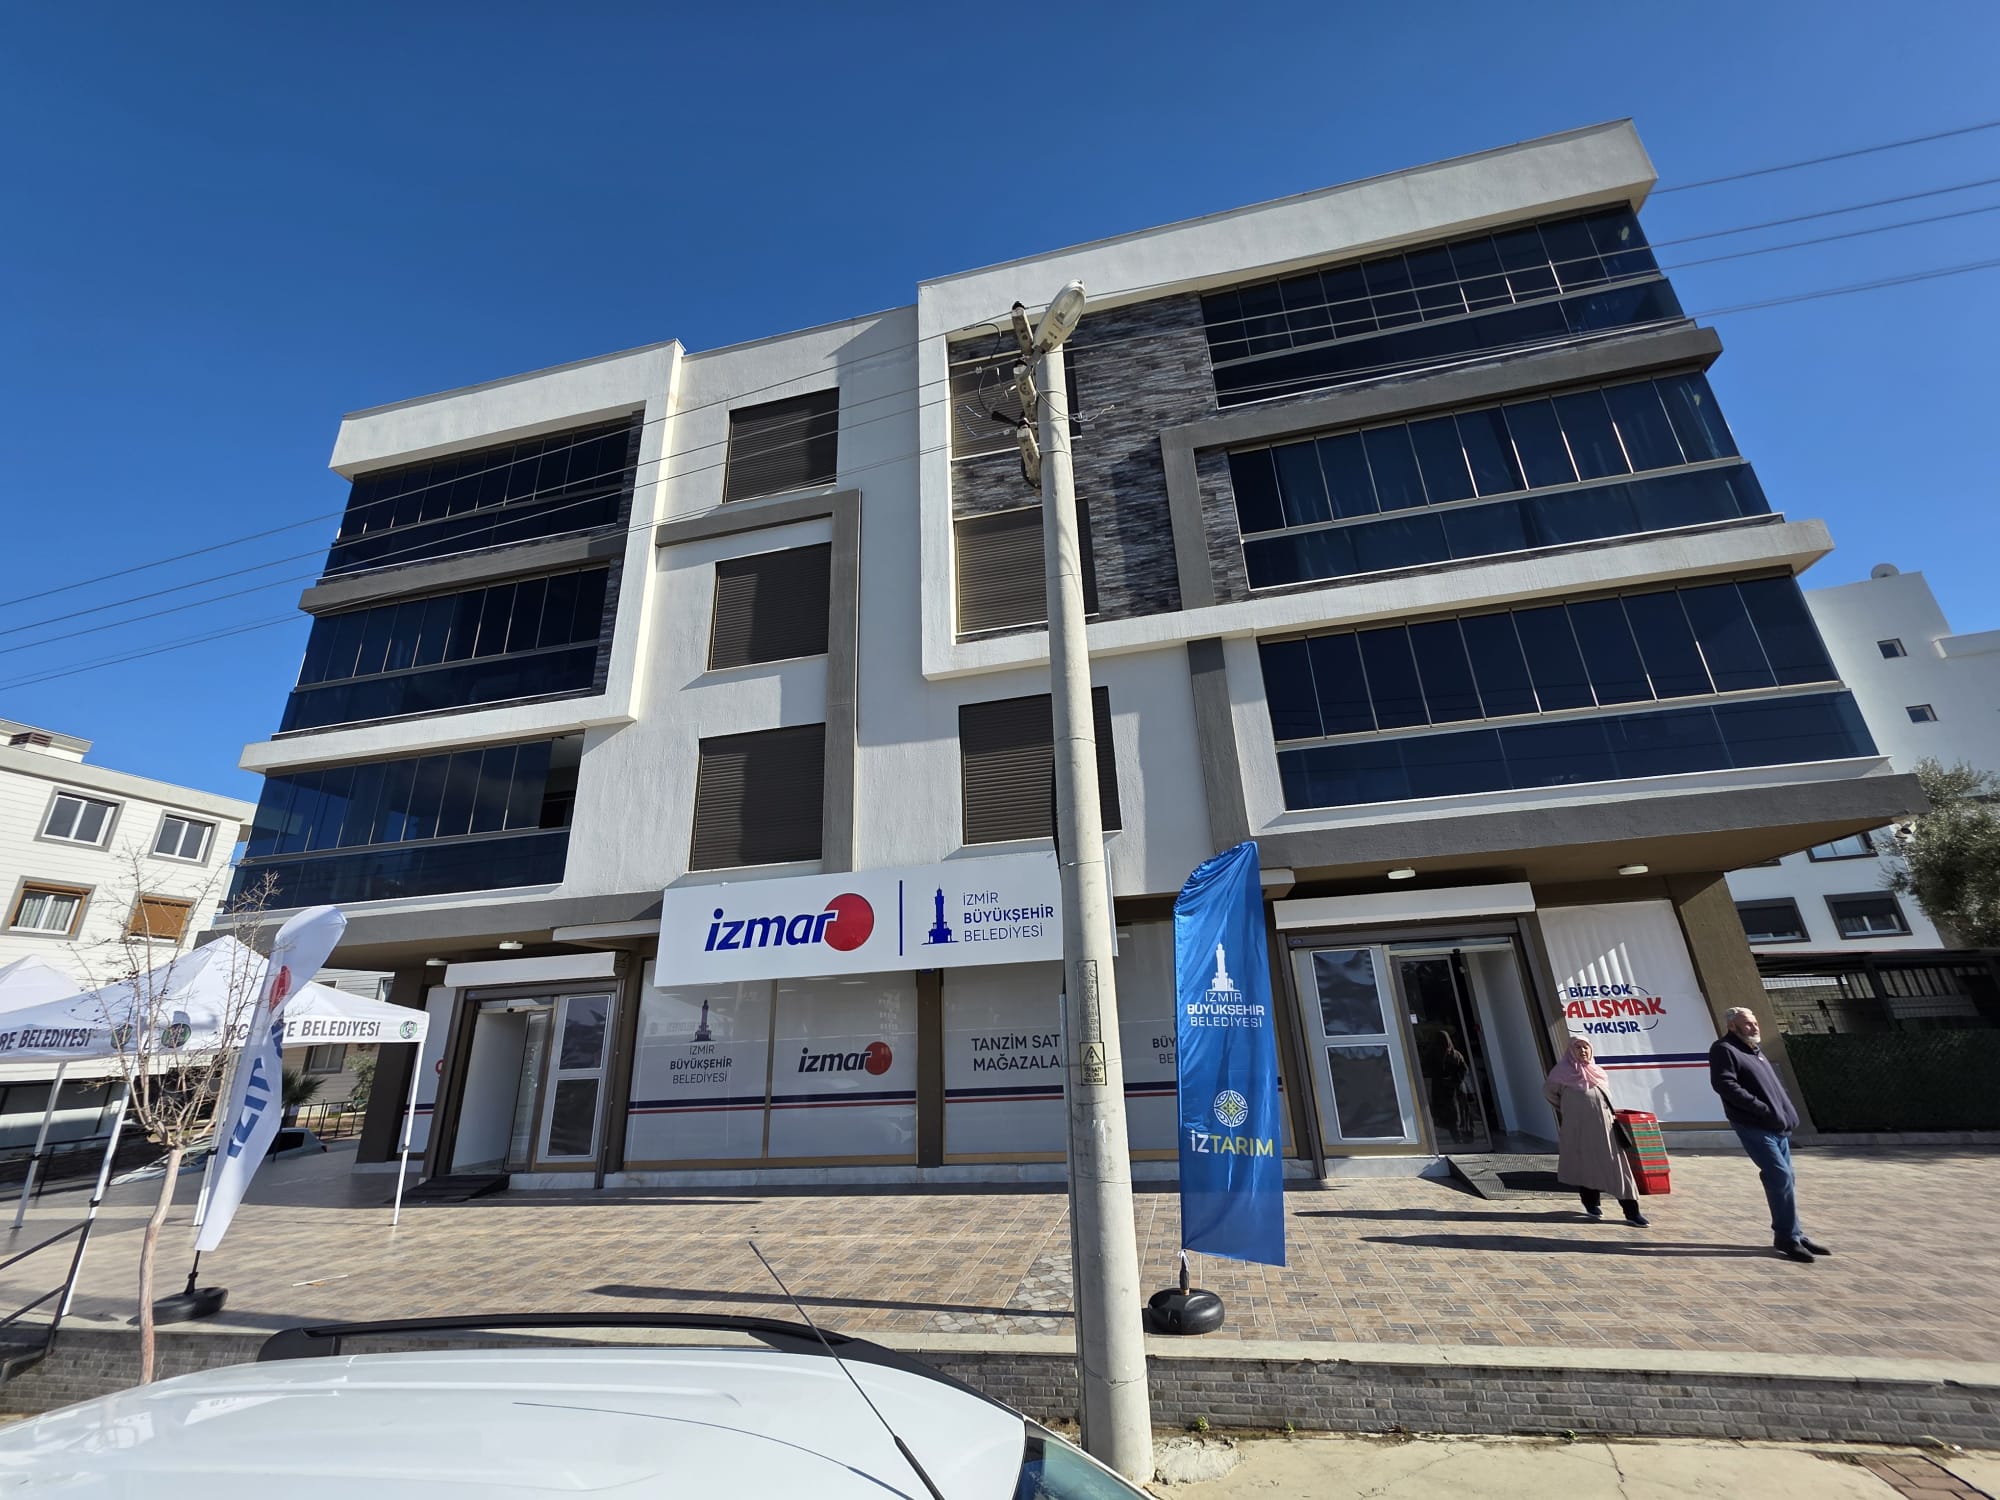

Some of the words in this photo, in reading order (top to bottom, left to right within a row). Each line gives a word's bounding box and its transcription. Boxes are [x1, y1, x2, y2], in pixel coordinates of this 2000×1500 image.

[963, 890, 999, 906] İZMİR
[963, 904, 1054, 924] BÜYÜKŞEHİR
[704, 908, 836, 952] izmar
[964, 922, 1043, 942] BELEDİYESİ
[1205, 991, 1243, 1003] İZMİR
[1569, 983, 1599, 998] BİZE
[1600, 983, 1633, 997] ÇOK
[1187, 1002, 1265, 1016] BÜYÜKŞEHİR
[1562, 997, 1667, 1019] ALIŞMAK
[301, 1020, 381, 1037] BELEDİYESİ
[1190, 1015, 1263, 1028] BELEDİYESİ
[1583, 1021, 1641, 1034] YAKIŞIR
[18, 1028, 93, 1049] BELEDİYESİ
[971, 1033, 1027, 1051] TANZİM
[670, 1056, 733, 1070] BÜYÜKŞEHİR
[798, 1047, 872, 1073] izmar
[973, 1053, 1062, 1071] MAĞAZALA
[672, 1071, 728, 1084] BELEDİYESİ
